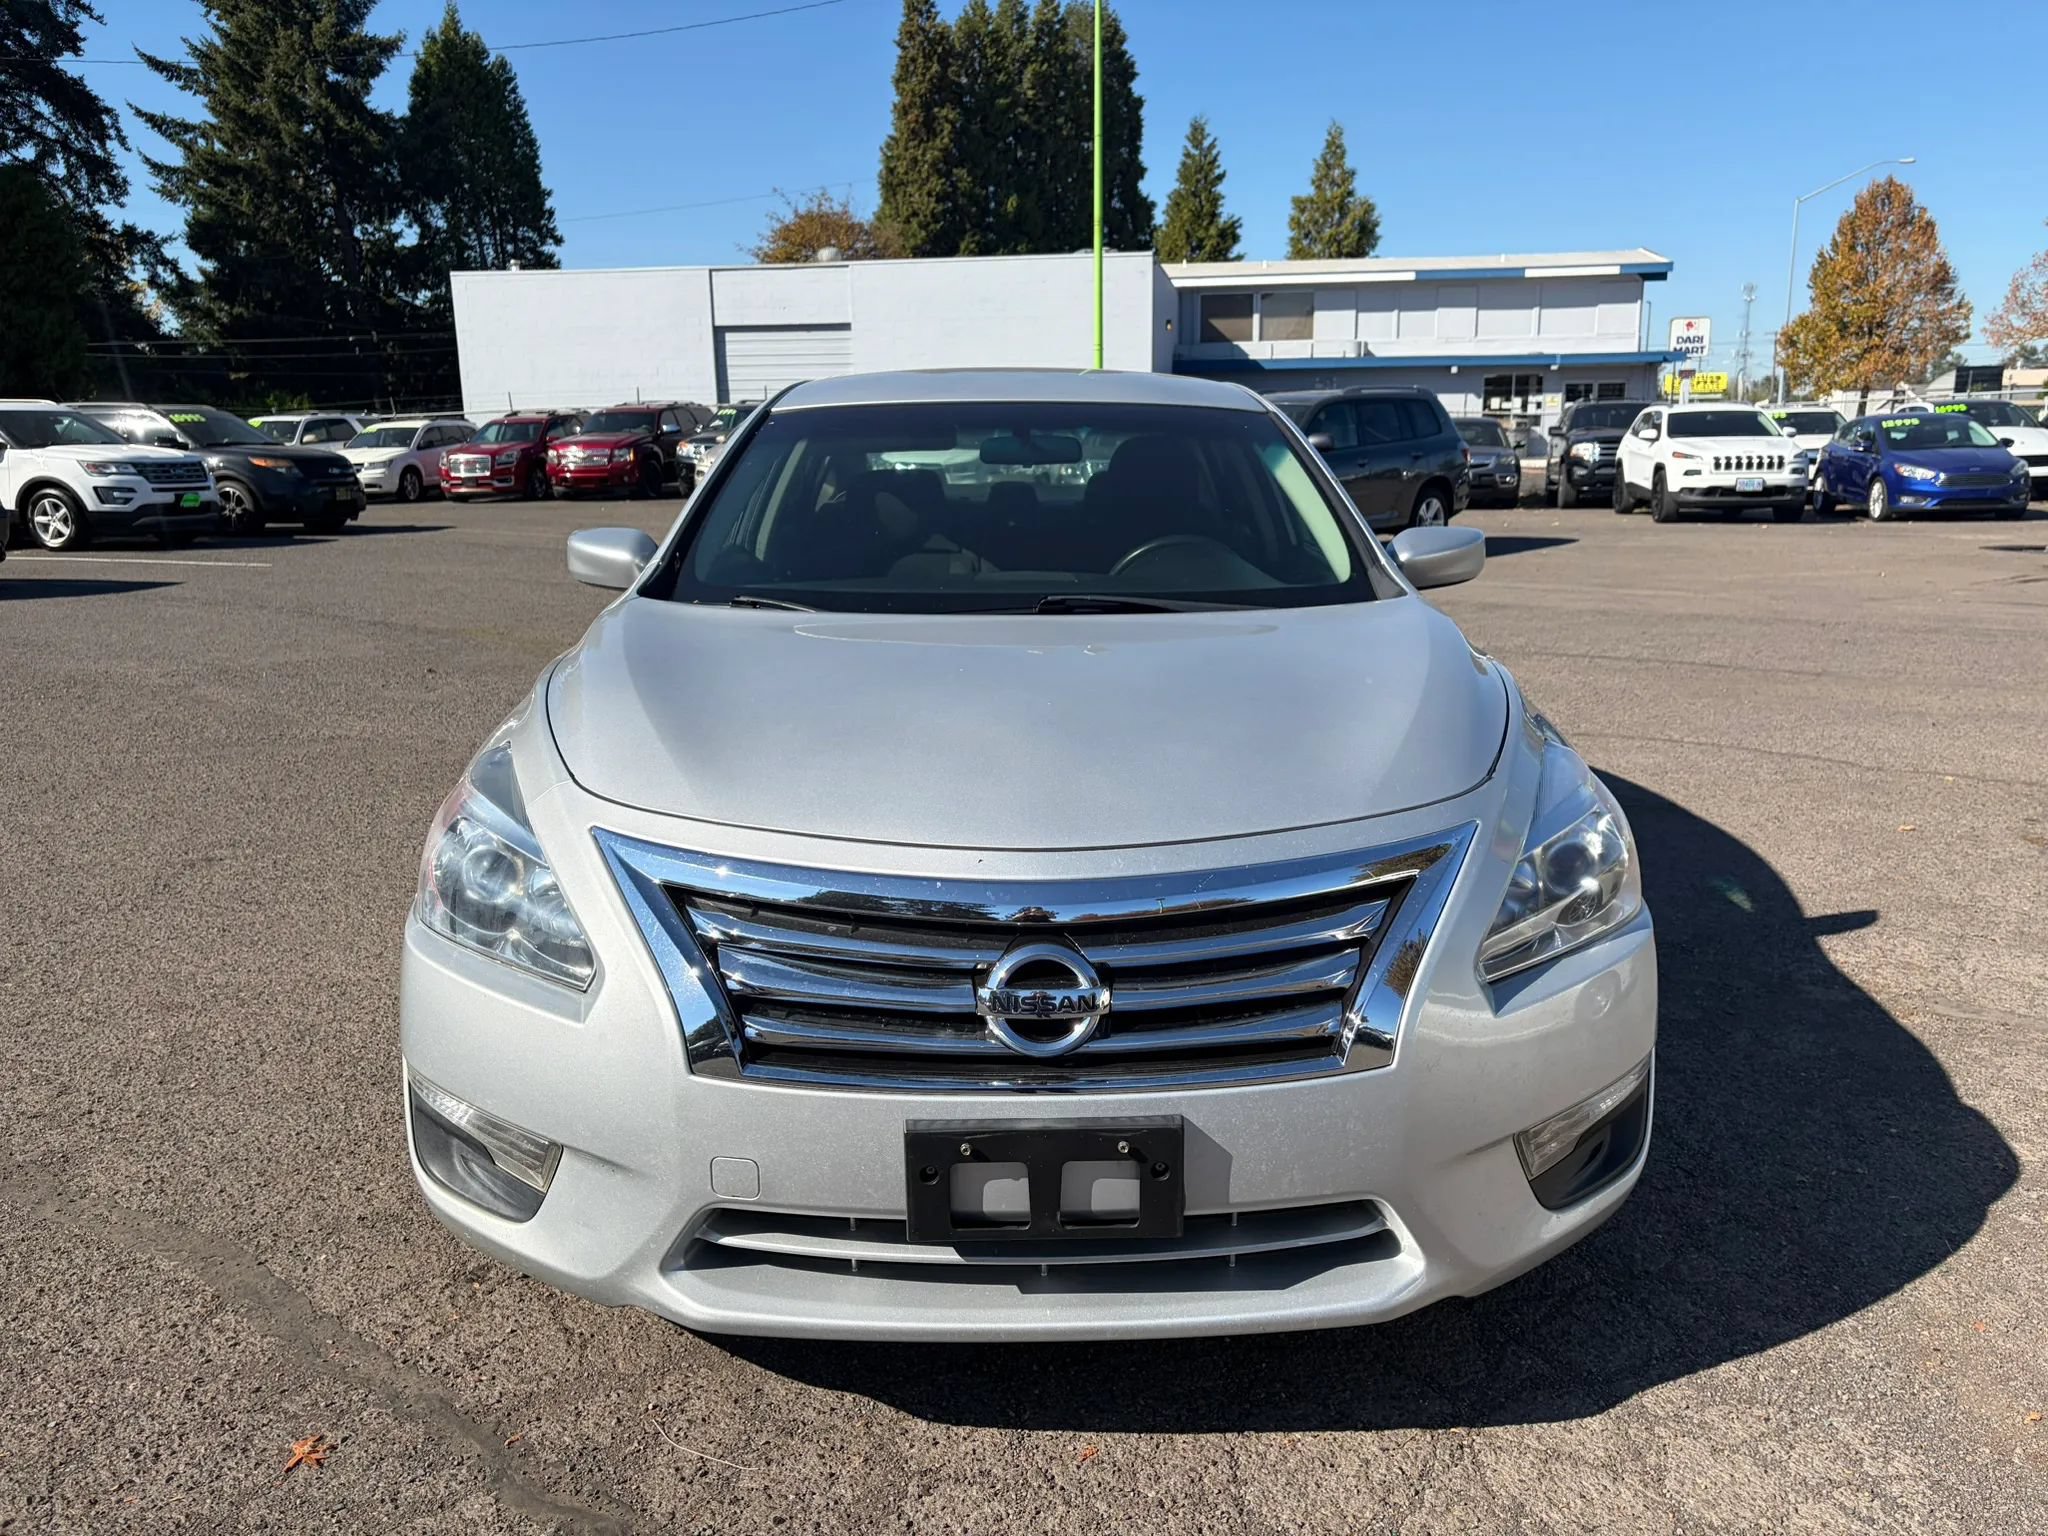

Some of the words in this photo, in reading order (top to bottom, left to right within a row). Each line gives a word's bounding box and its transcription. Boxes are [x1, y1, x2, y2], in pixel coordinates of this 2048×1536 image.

[1676, 336, 1704, 345] DARI
[1673, 346, 1705, 354] MART
[991, 991, 1098, 1013] NISSAN
